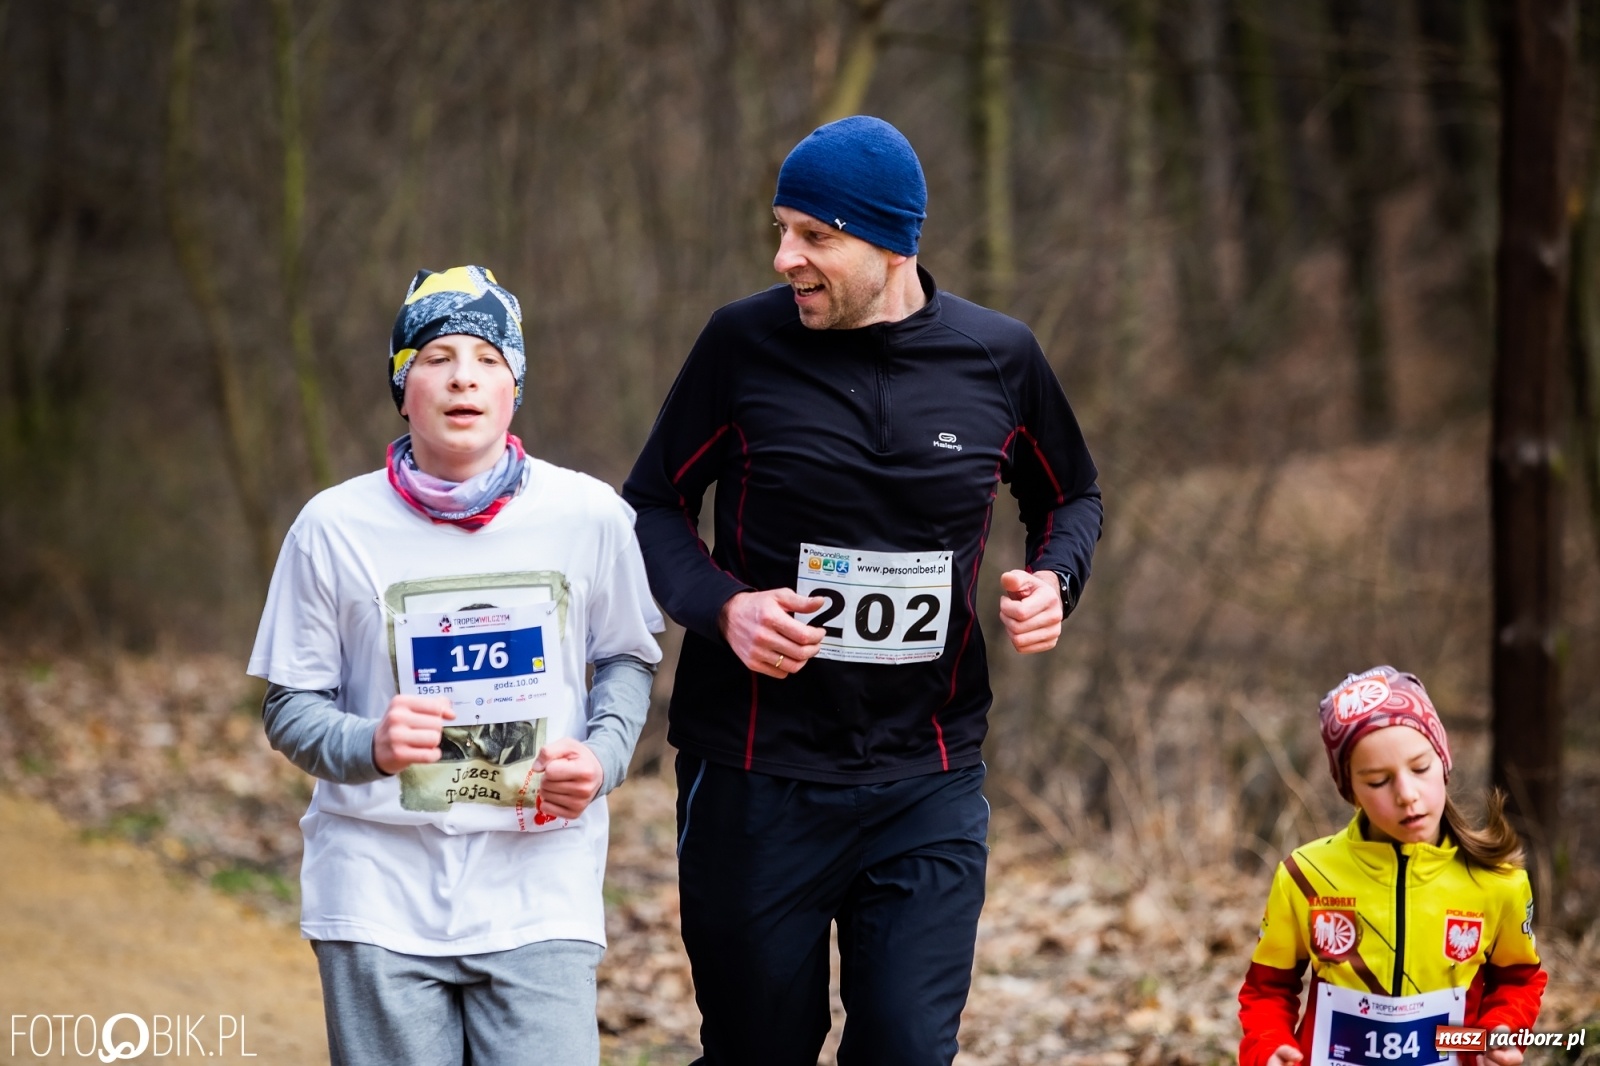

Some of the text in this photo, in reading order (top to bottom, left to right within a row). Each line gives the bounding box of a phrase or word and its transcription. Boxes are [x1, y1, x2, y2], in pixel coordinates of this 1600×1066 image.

[809, 549, 850, 560] PersonalBest
[857, 563, 946, 576] www.personalbest.pl
[806, 587, 941, 643] 202
[450, 641, 509, 673] 176
[417, 686, 441, 695] 1963
[446, 784, 501, 804] Tojan
[1446, 909, 1485, 918] POLSKA
[1364, 1030, 1420, 1060] 184
